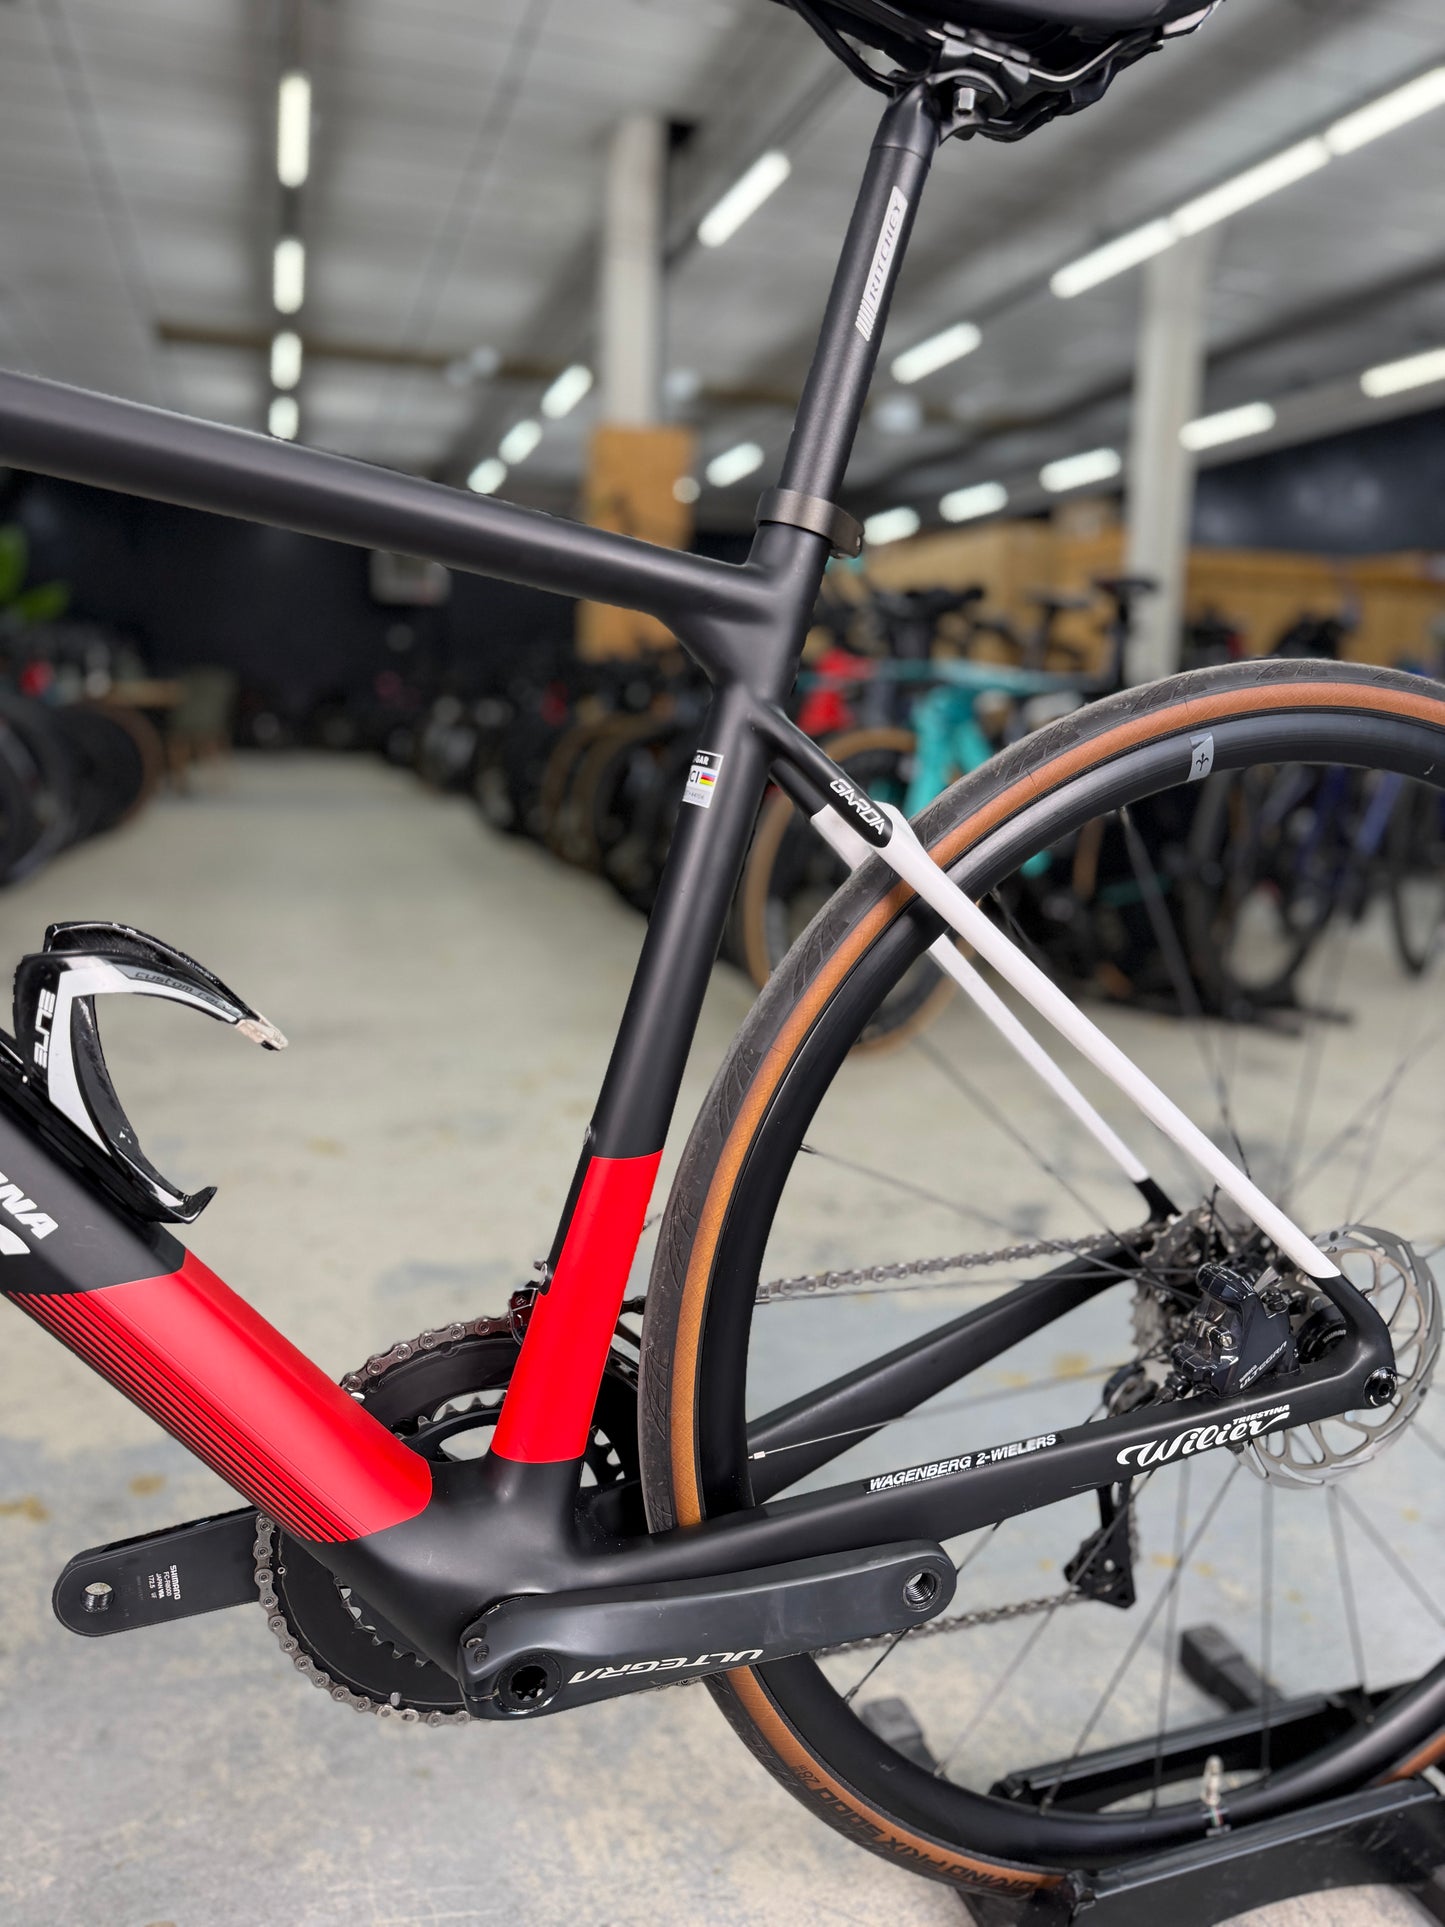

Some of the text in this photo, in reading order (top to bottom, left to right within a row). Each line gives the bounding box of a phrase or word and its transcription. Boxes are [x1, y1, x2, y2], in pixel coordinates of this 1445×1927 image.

[869, 199, 901, 301] RITCHEY
[692, 754, 710, 766] GAR
[829, 778, 886, 836] GARDA
[1239, 1340, 1288, 1390] ULTEGRA
[1232, 1403, 1291, 1426] TRIESTINA
[1116, 1411, 1291, 1468] Wilier
[870, 1433, 1057, 1491] WAGENBERG 2-WIELERS
[169, 1564, 181, 1601] SHIMANO
[567, 1649, 764, 1684] ULTEGRA
[813, 1787, 886, 1838] 5000
[878, 1837, 946, 1873] PRIX
[948, 1864, 1038, 1892] GRAND
